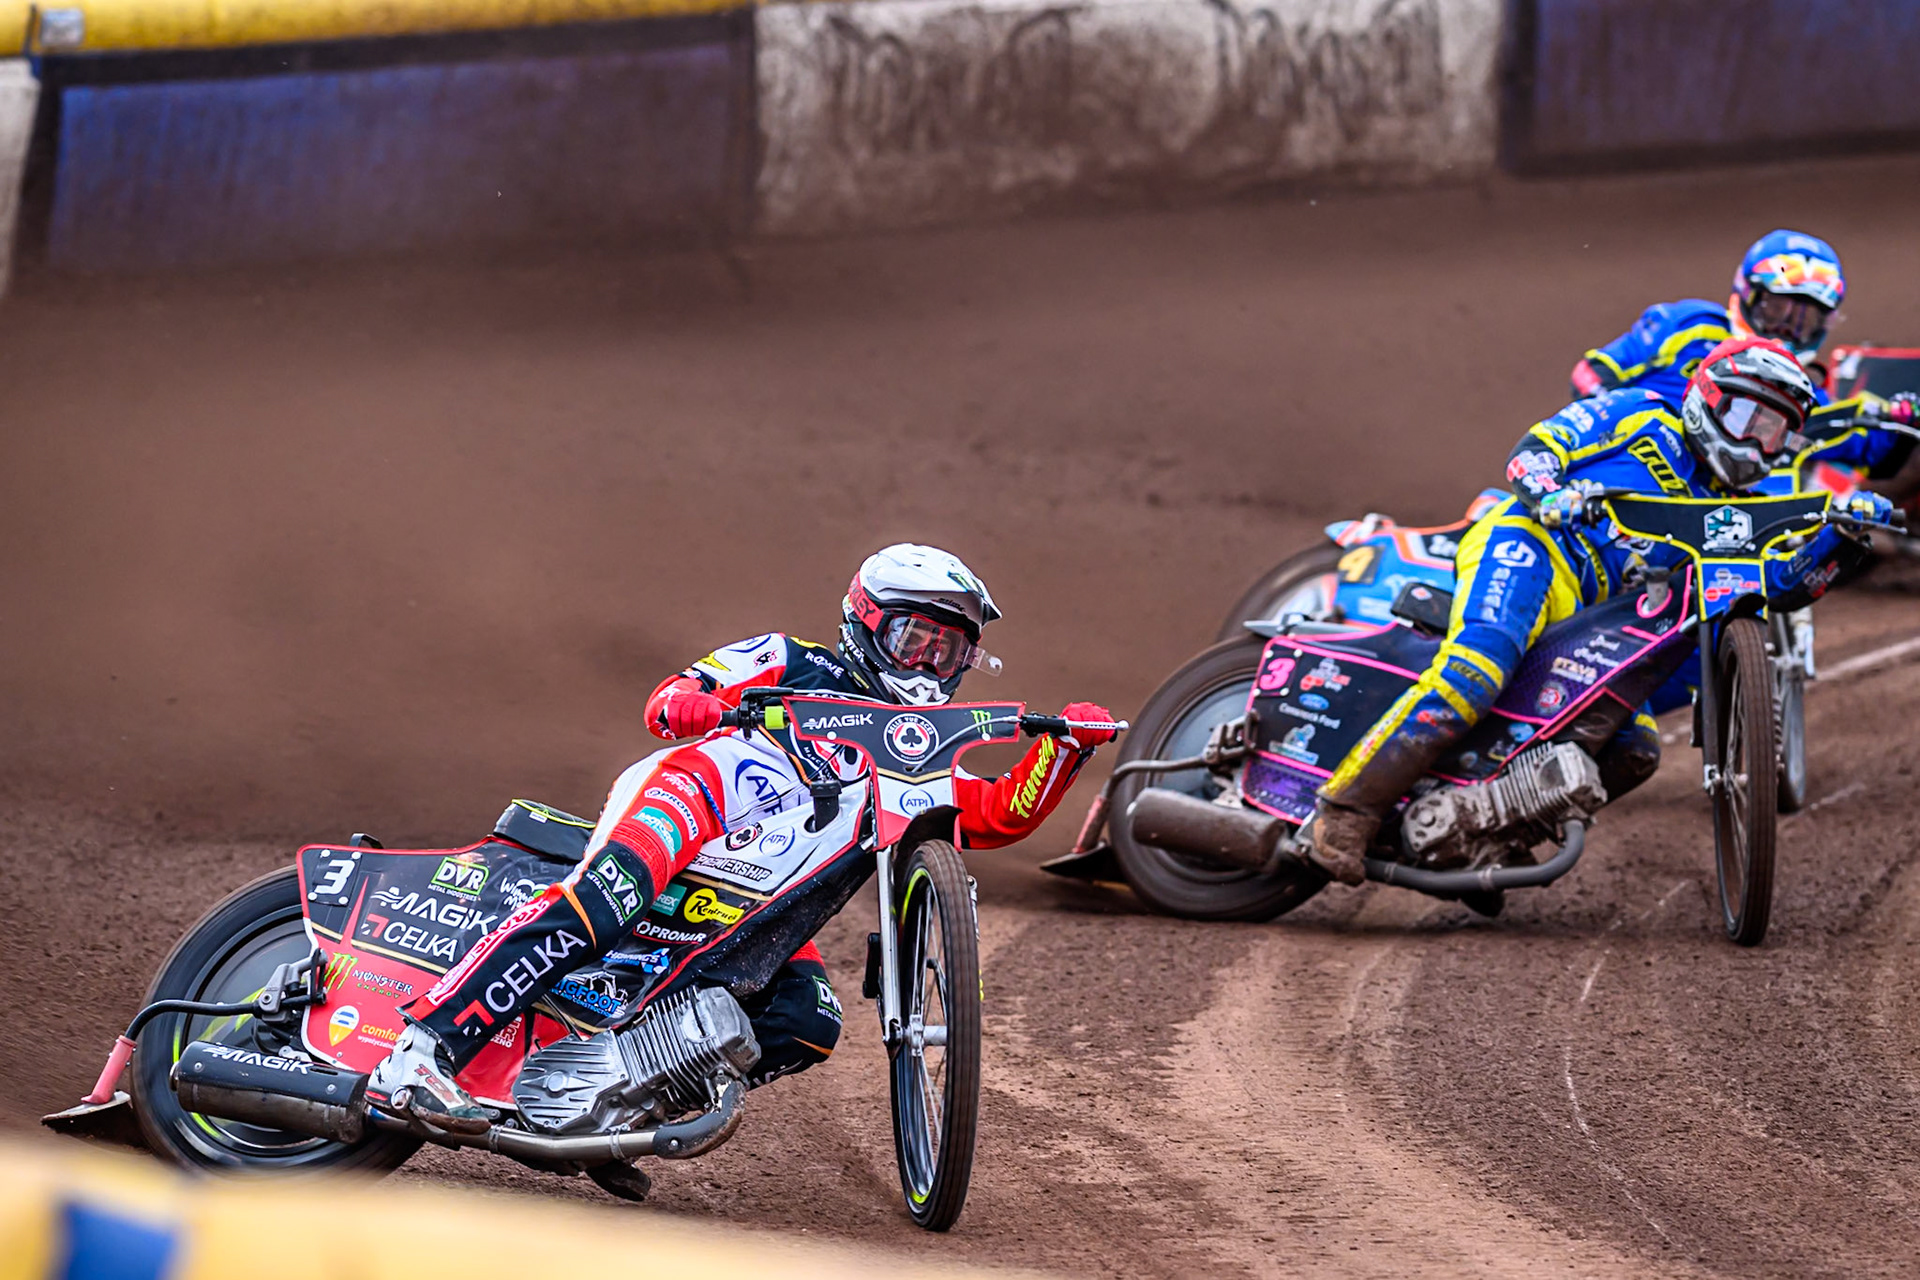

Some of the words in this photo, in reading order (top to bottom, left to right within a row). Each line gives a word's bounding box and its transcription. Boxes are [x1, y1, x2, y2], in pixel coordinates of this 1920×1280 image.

[1338, 546, 1374, 581] 4
[804, 651, 845, 679] ROWE
[1259, 657, 1296, 690] 3
[1010, 735, 1055, 819] Family
[906, 796, 928, 808] ATPI
[766, 833, 789, 847] ATPI
[314, 858, 355, 895] 3
[427, 883, 446, 894] METAL
[446, 889, 478, 902] INDUSTRIES
[436, 862, 485, 890] DVR
[597, 859, 638, 916] DVR
[601, 888, 625, 927] INDUSTRIES
[383, 921, 460, 963] CELKA
[648, 925, 707, 943] PRONAR
[352, 969, 414, 996] MONSTER
[485, 929, 588, 1014] CELKA
[357, 982, 401, 999] ENERGY
[816, 981, 843, 1014] DV
